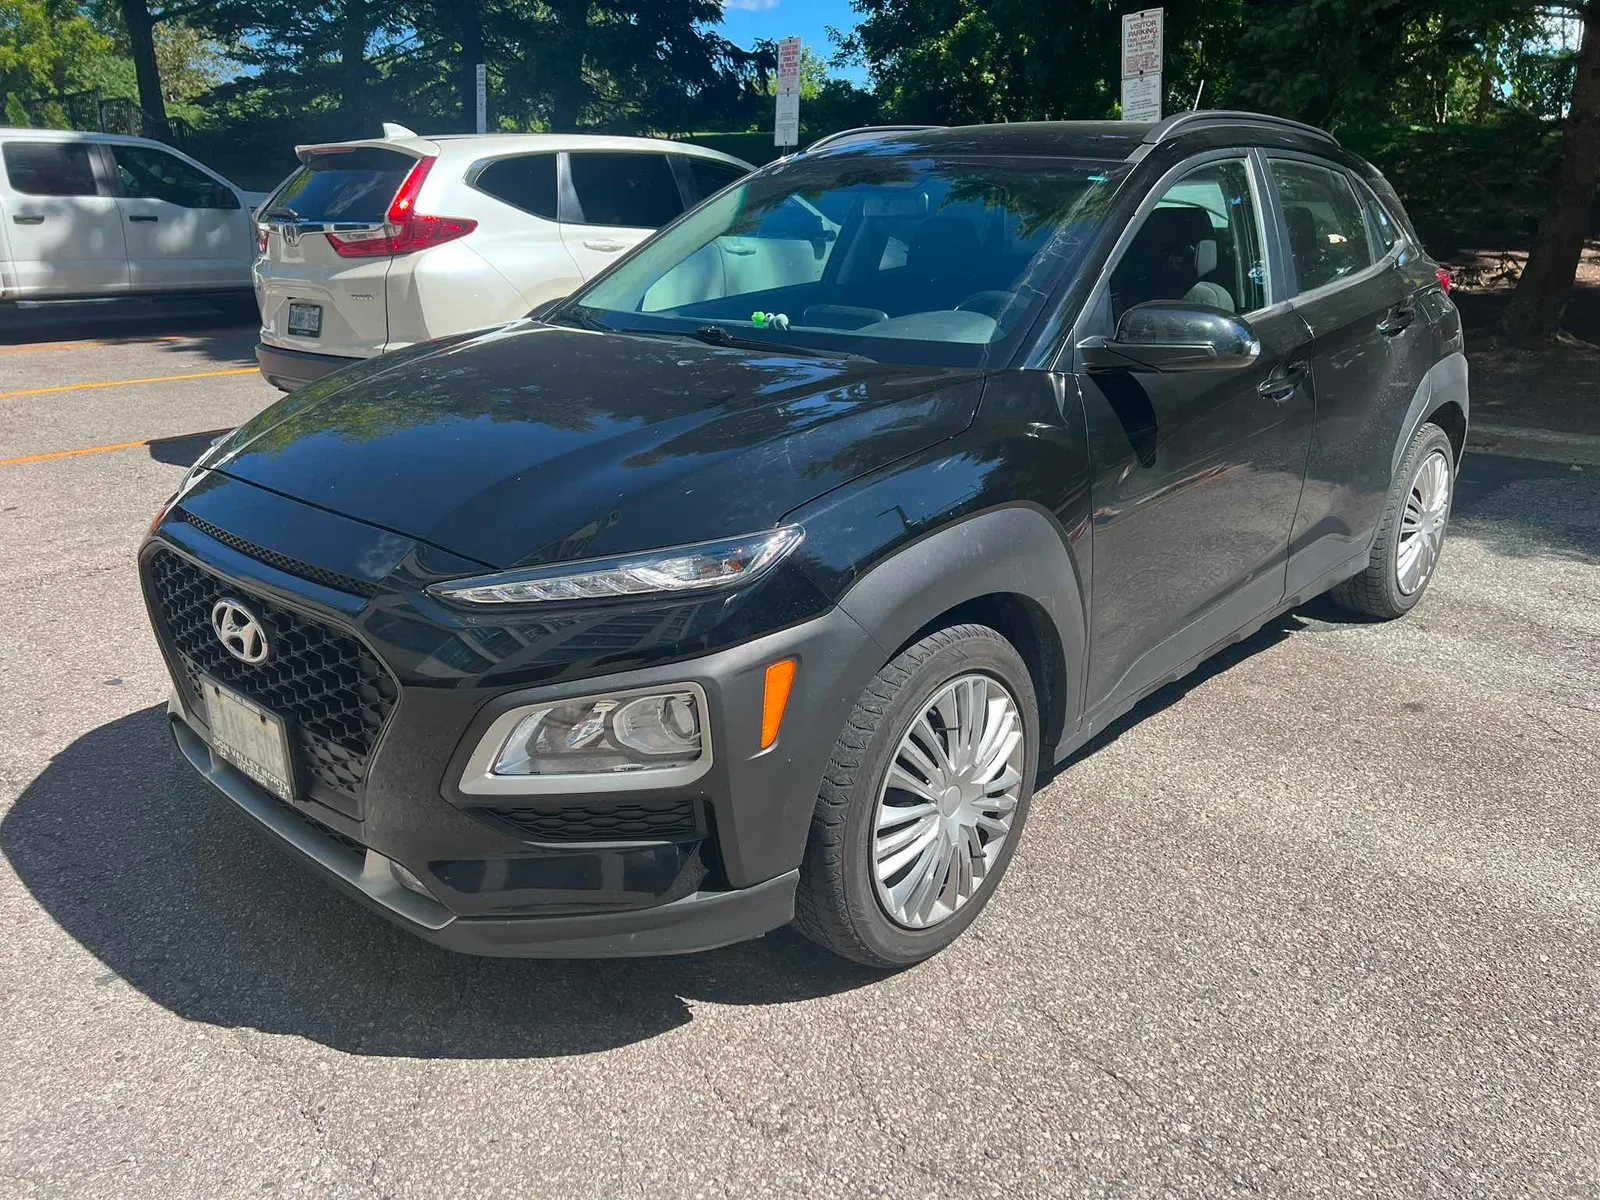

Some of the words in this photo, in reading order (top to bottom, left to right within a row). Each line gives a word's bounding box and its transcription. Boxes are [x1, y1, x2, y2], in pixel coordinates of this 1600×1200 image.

[1130, 20, 1157, 30] VISITOR
[1128, 27, 1158, 38] PARKING
[214, 736, 230, 753] DON
[232, 749, 260, 772] VALLEY
[261, 768, 291, 793] NORTH
